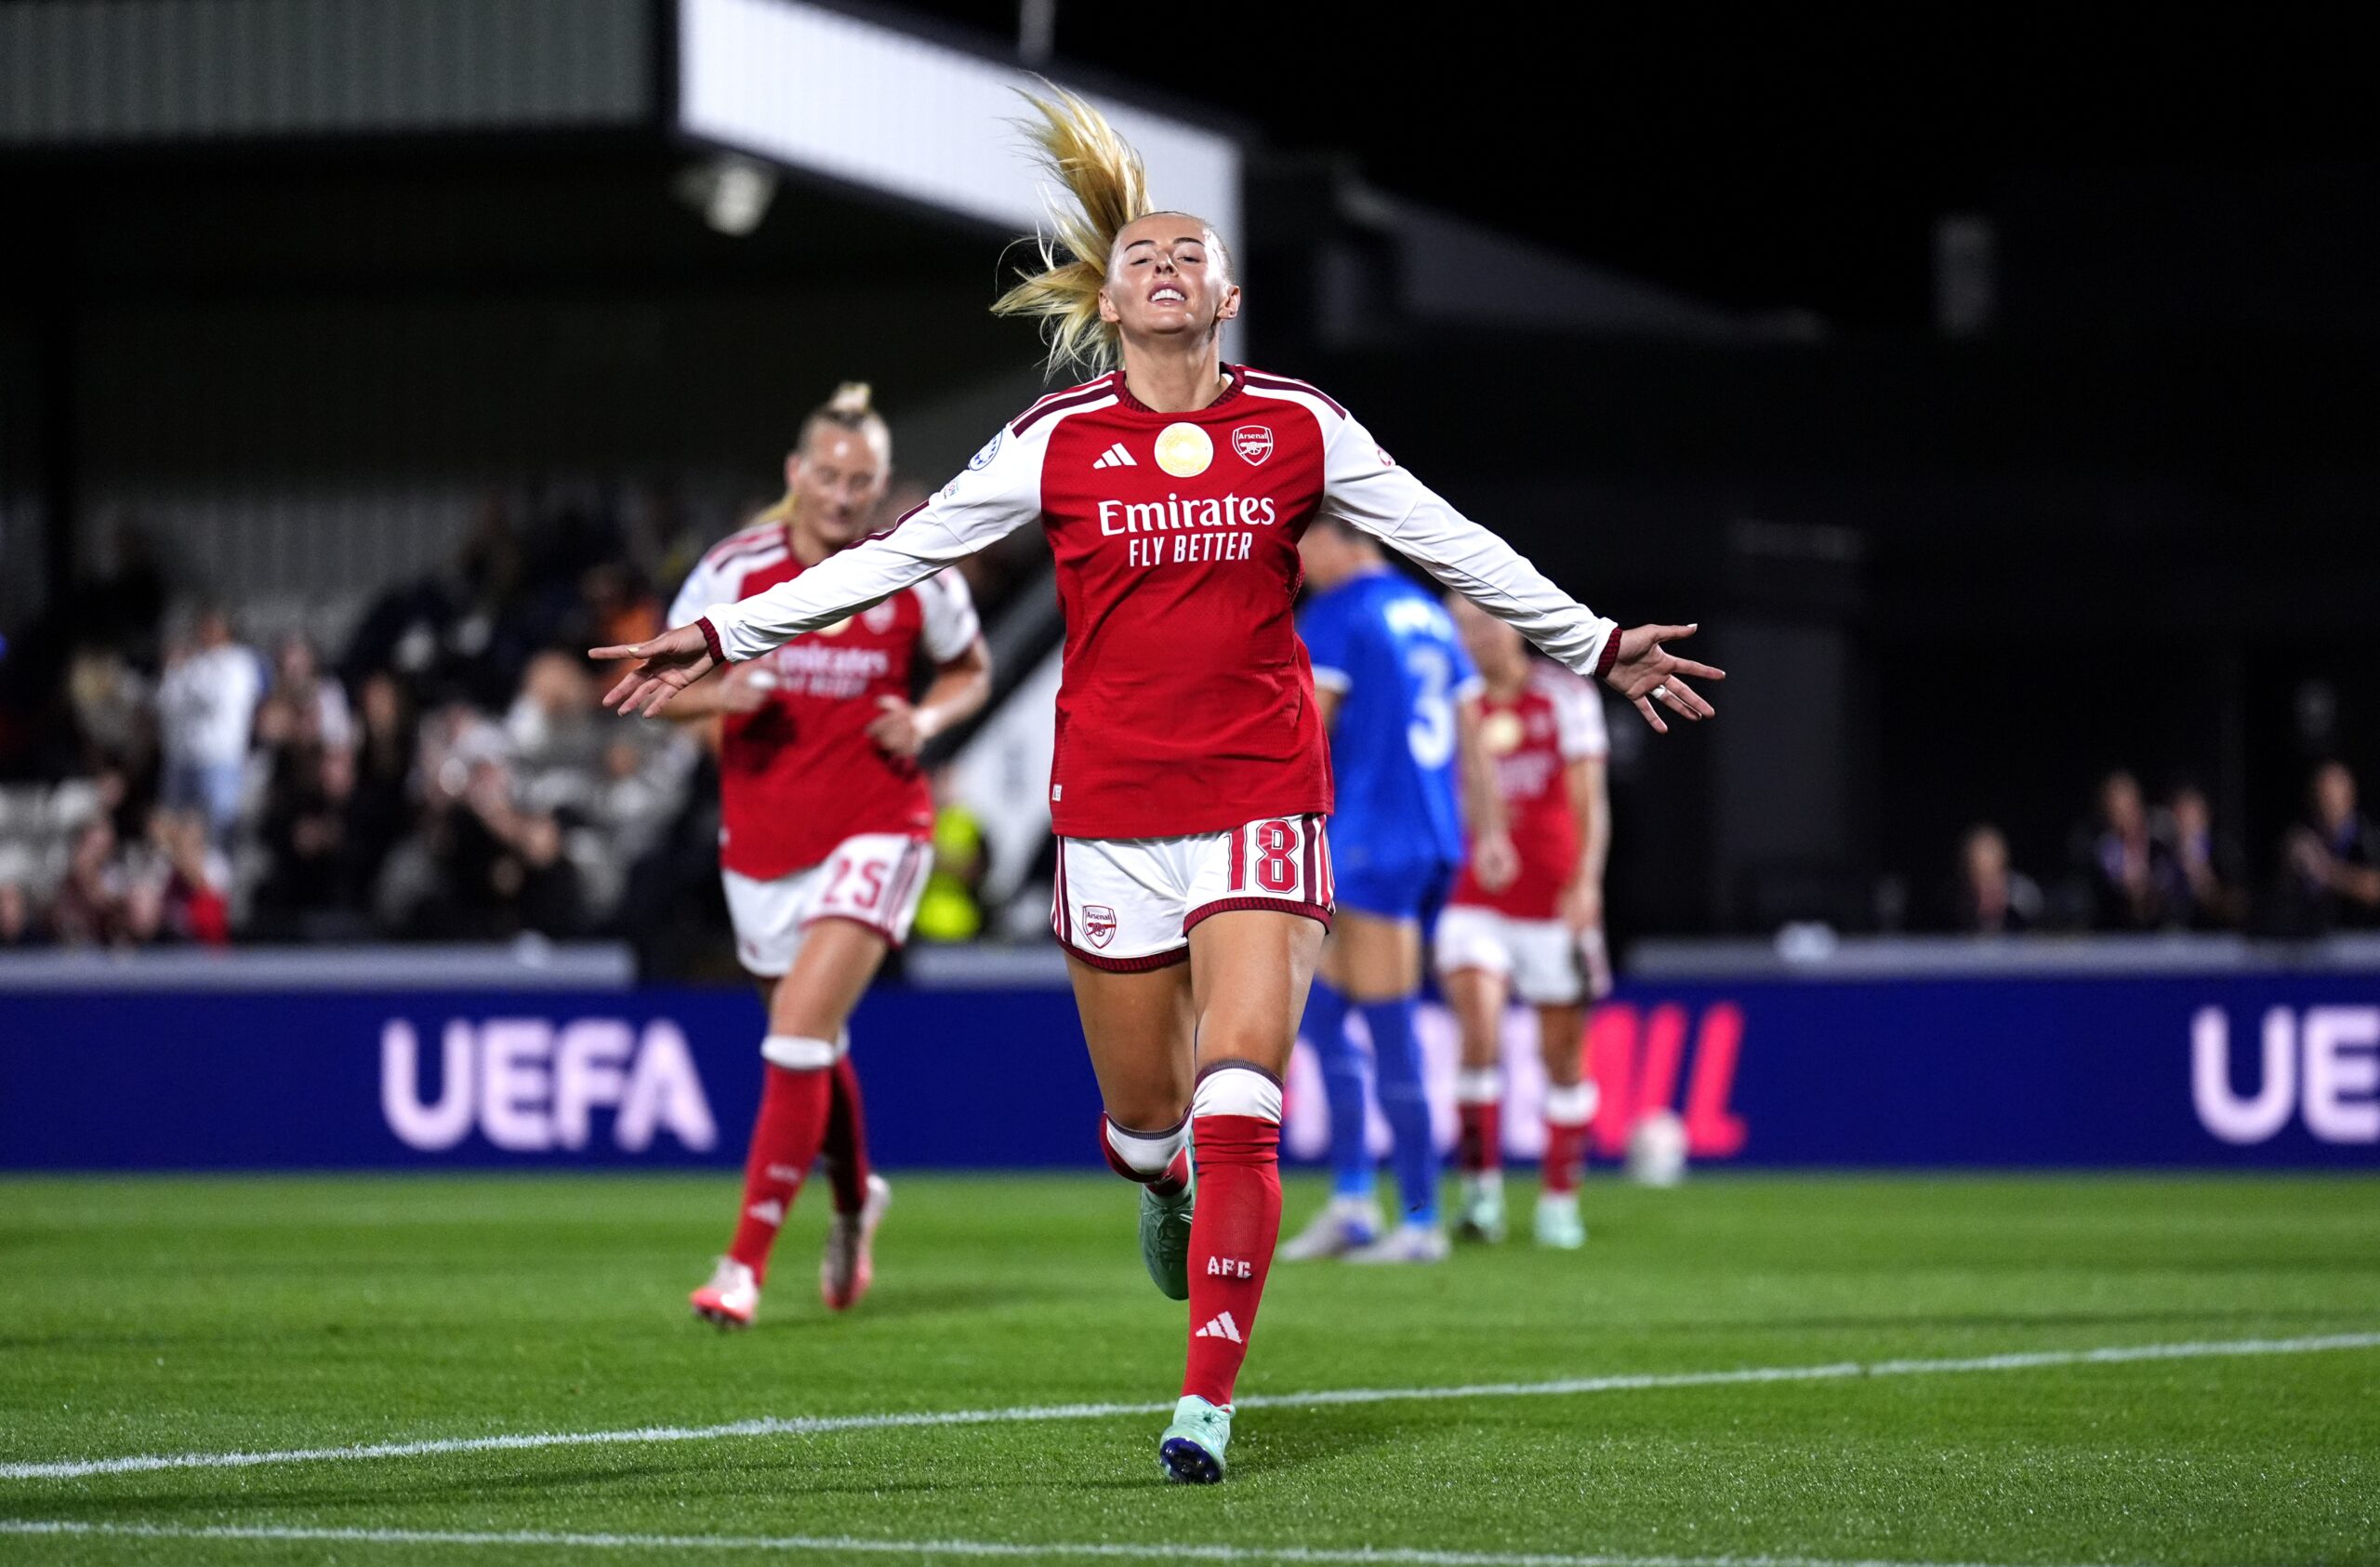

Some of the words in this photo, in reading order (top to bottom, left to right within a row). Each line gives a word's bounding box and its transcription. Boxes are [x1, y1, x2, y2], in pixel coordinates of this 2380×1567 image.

[1098, 493, 1276, 537] Emirates
[1130, 537, 1164, 567] FLY
[1173, 532, 1253, 563] BETTER
[1406, 644, 1457, 771] 3
[1222, 818, 1300, 894] 18
[822, 857, 888, 910] 25
[1087, 911, 1111, 921] Arsenal
[380, 1018, 719, 1152] UEFA
[1207, 1255, 1252, 1279] AFC
